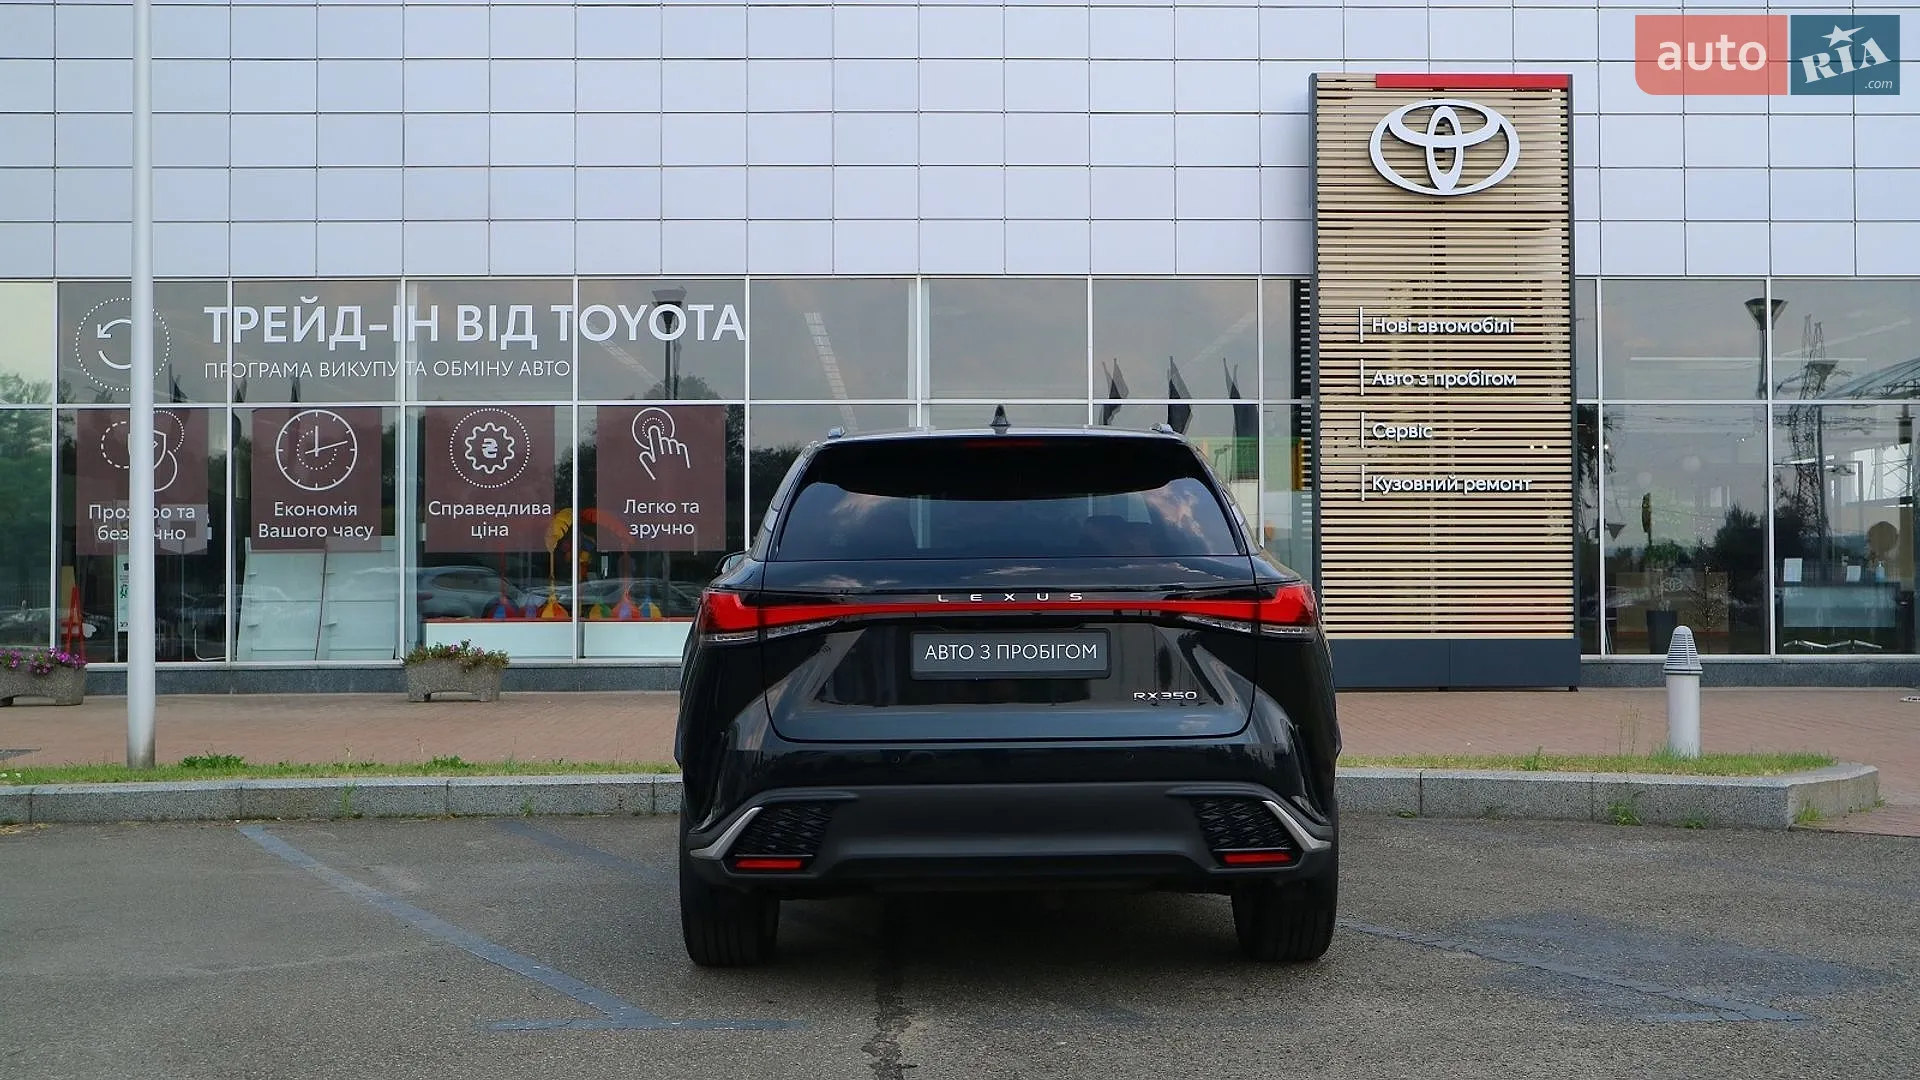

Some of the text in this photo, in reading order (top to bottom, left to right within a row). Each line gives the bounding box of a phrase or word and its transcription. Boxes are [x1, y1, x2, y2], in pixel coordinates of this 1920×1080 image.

[203, 295, 745, 351] ТРЕЙД-ІН ВІД TOYOTA
[1372, 317, 1515, 333] Нові автомобілі
[205, 361, 313, 379] ПРОГРАМА
[320, 360, 400, 377] ВИКУПУ
[433, 360, 513, 376] ОБМІНУ
[518, 360, 570, 376] АВТО
[1371, 371, 1414, 386] Авто
[1434, 370, 1517, 388] пробігом
[1372, 423, 1433, 441] Сервіс
[1372, 475, 1532, 495] Кузовний ремонт
[89, 504, 195, 522] Проо та
[274, 501, 357, 518] Економія
[428, 501, 551, 517] Справедлива
[624, 499, 700, 515] Легко та
[97, 525, 186, 540] безчно
[258, 524, 374, 541] Вашого часу
[471, 523, 509, 540] ціна
[629, 523, 695, 538] зручно
[938, 593, 1083, 602] LEXUS
[925, 644, 974, 660] АВТО
[997, 644, 1097, 660] ПРОБІГОМ
